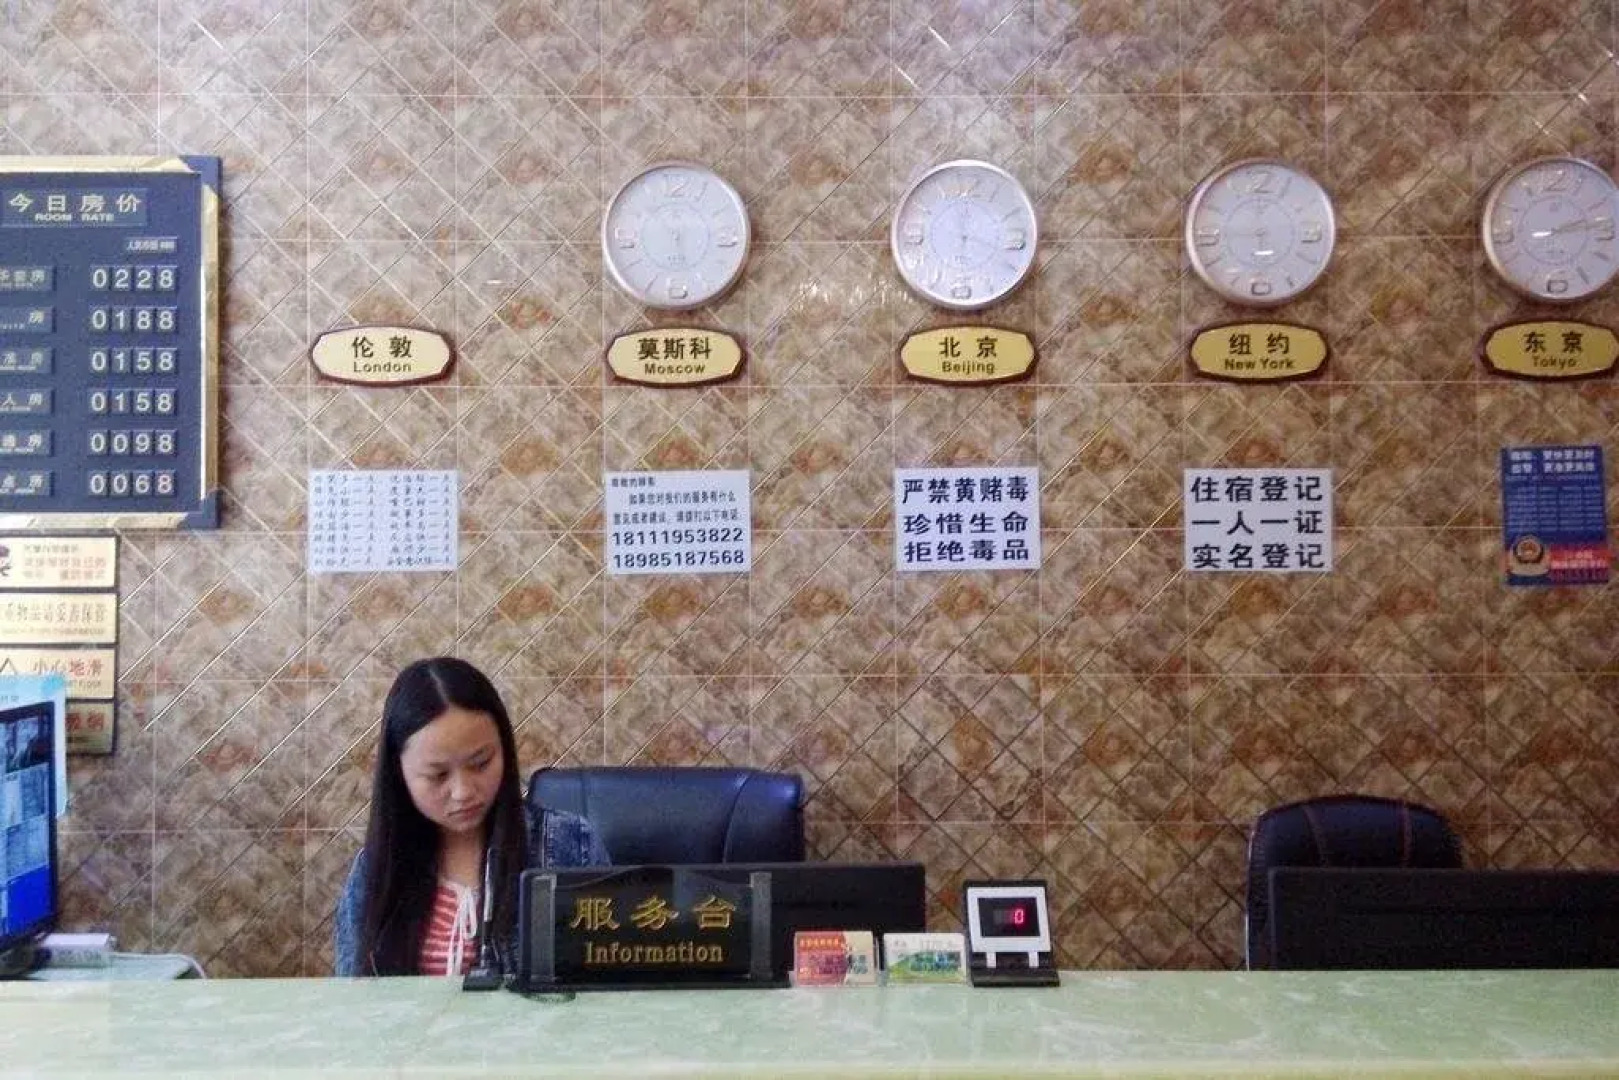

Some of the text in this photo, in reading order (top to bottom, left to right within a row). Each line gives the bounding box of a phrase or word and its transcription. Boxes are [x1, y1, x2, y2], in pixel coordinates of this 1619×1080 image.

[8, 193, 142, 213] 今日房价
[35, 213, 114, 222] ROOM RATE
[92, 268, 173, 289] 0228
[92, 310, 174, 330] 0188
[352, 335, 412, 358] 伦敦
[638, 337, 711, 360] 莫斯科
[938, 335, 998, 358] 北京
[1228, 333, 1290, 355] 纽约
[1523, 331, 1584, 354] 东京
[91, 352, 173, 370] 0158
[353, 361, 412, 373] London
[644, 363, 706, 375] Moscow
[941, 361, 995, 375] Beijing
[1224, 359, 1295, 370] New York
[1531, 355, 1577, 370] Tokyo
[91, 393, 172, 411] 0158
[90, 434, 172, 452] 0098
[90, 474, 172, 493] 0068
[902, 476, 1029, 504] 严禁黄赌毒
[1190, 476, 1323, 503] 住宿登记
[903, 511, 1029, 535] 珍惜生命
[1191, 510, 1323, 535] 一人一证
[612, 528, 744, 546] 18111953822
[613, 550, 745, 568] 18985187568
[904, 539, 1029, 563] 拒绝毒品
[1192, 543, 1324, 569] 实名登记
[569, 895, 737, 931] 服务台
[1014, 908, 1024, 925] 0
[584, 941, 724, 963] Information
